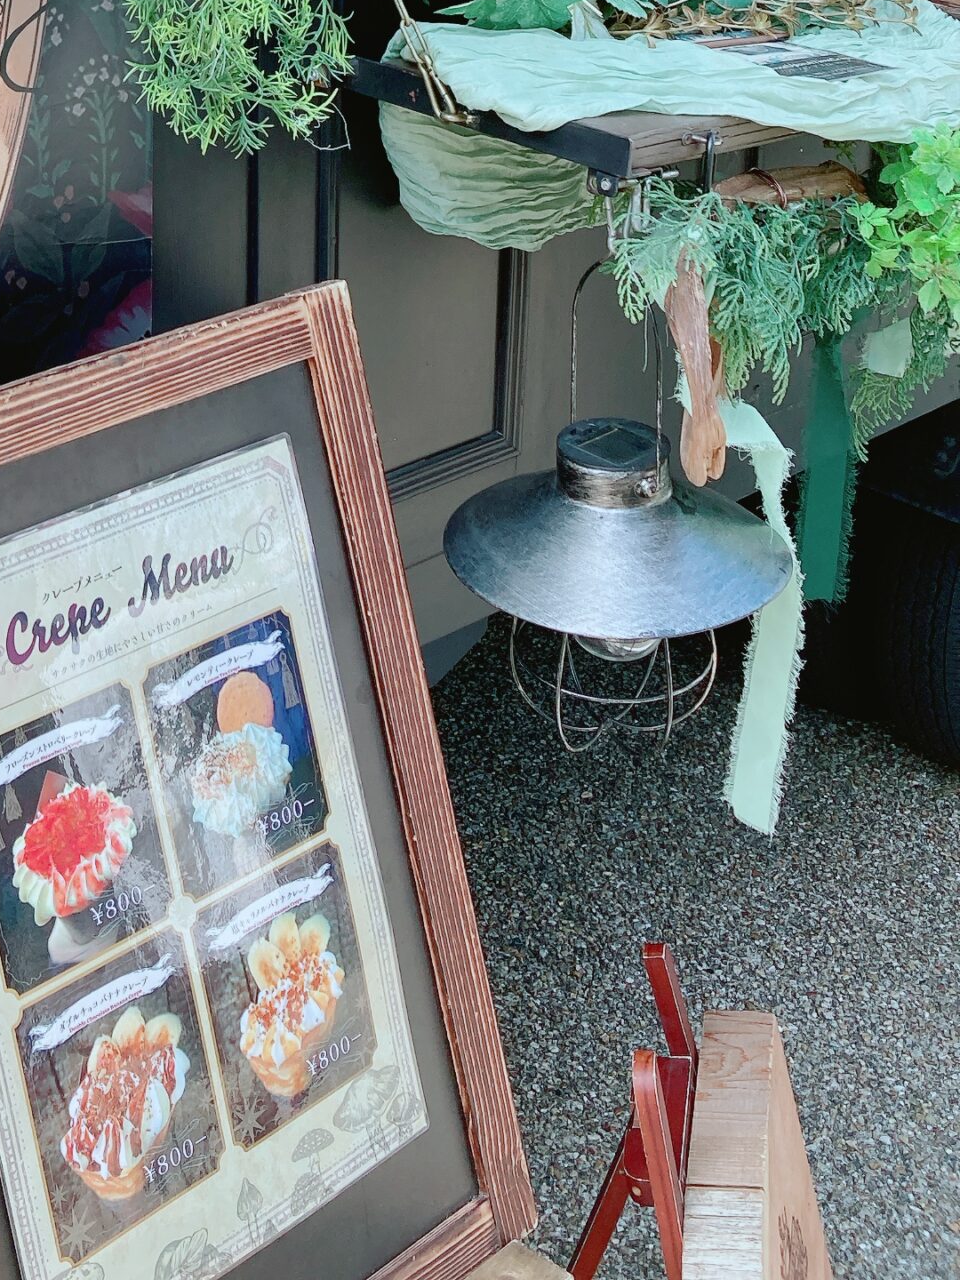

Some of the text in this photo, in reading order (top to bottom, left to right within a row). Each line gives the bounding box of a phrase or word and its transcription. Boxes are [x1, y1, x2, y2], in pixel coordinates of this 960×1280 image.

[6, 545, 234, 665] Crepe Menu
[42, 565, 122, 605] クレープメニュー
